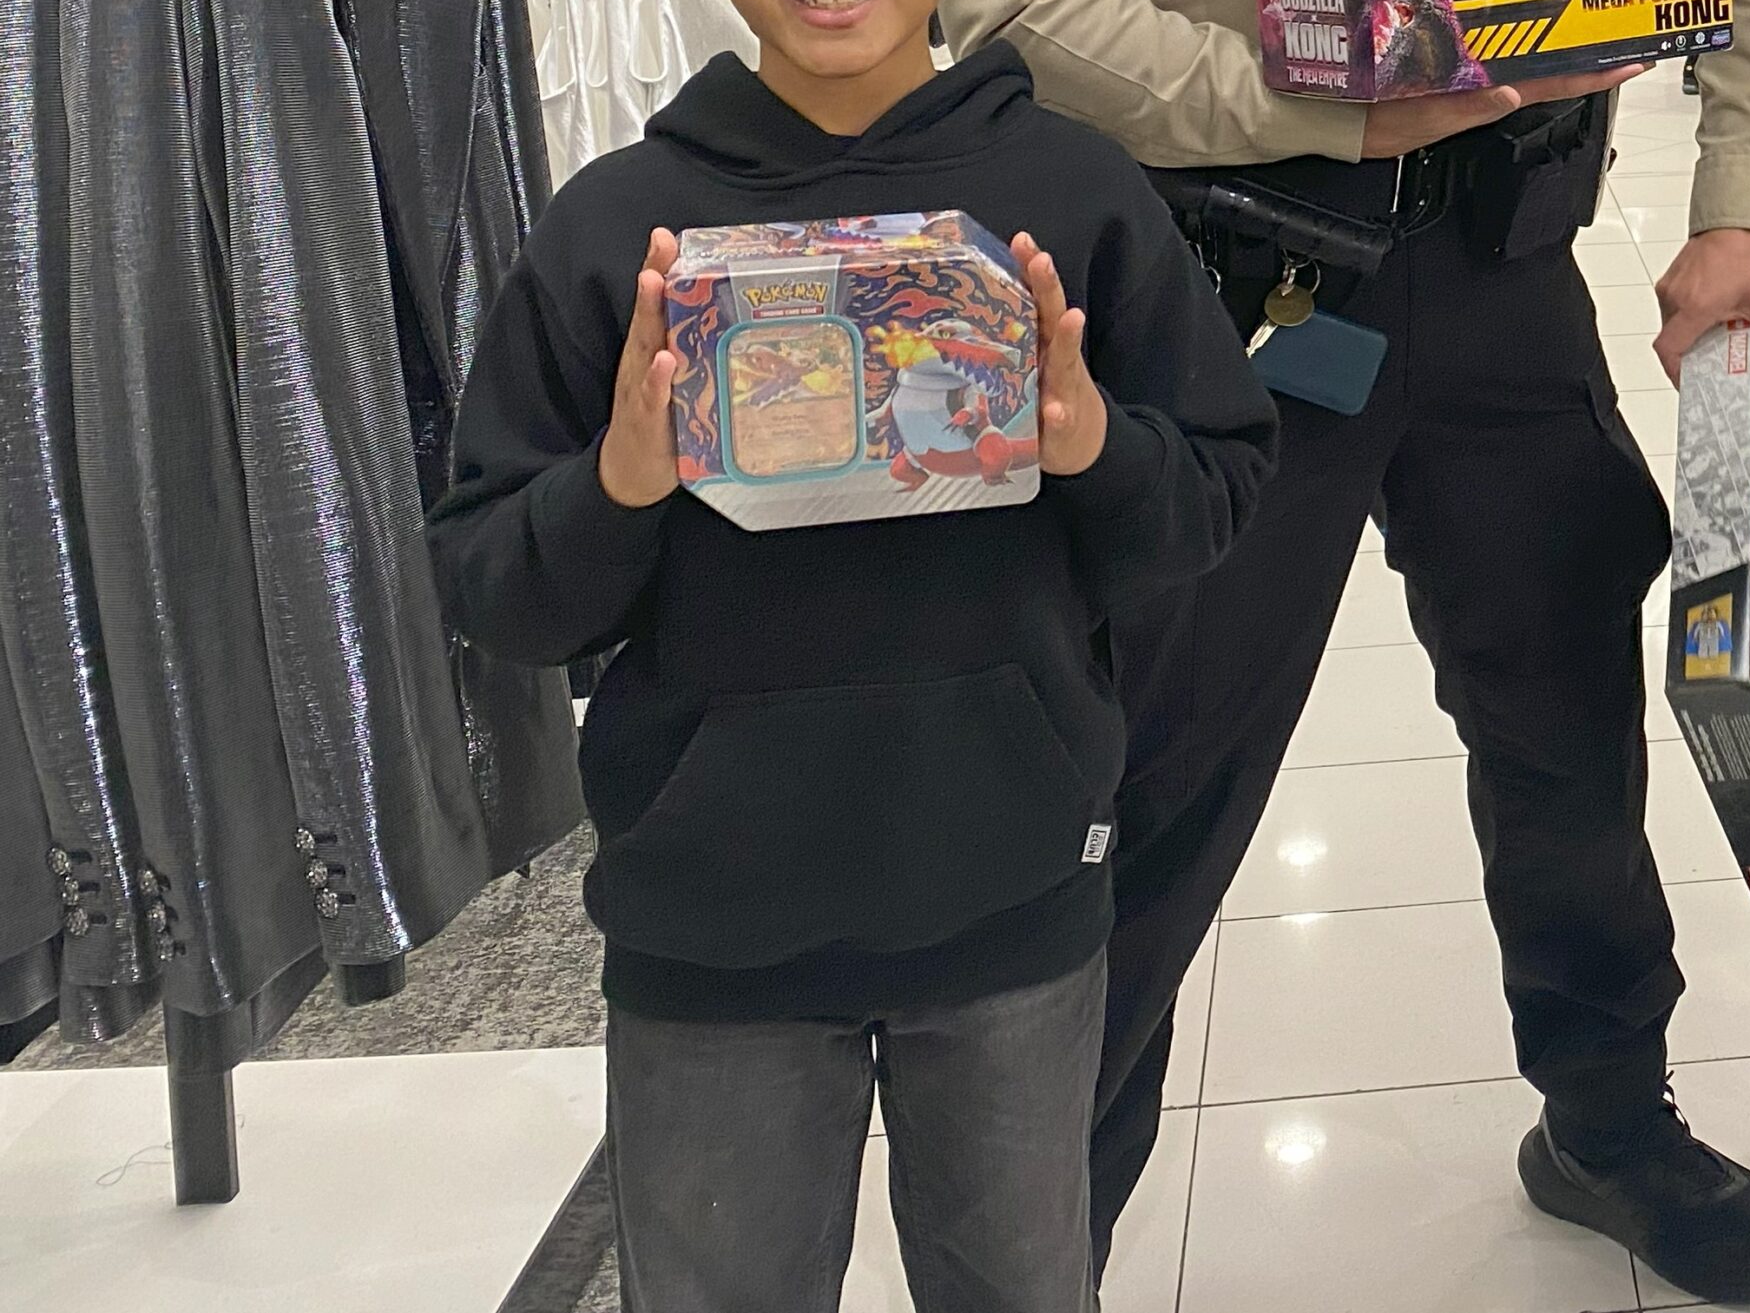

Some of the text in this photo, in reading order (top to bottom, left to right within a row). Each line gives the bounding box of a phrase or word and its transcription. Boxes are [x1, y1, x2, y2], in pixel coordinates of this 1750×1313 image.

[1284, 21, 1349, 65] KONG
[1286, 66, 1349, 88] THE NEW EMPIRE
